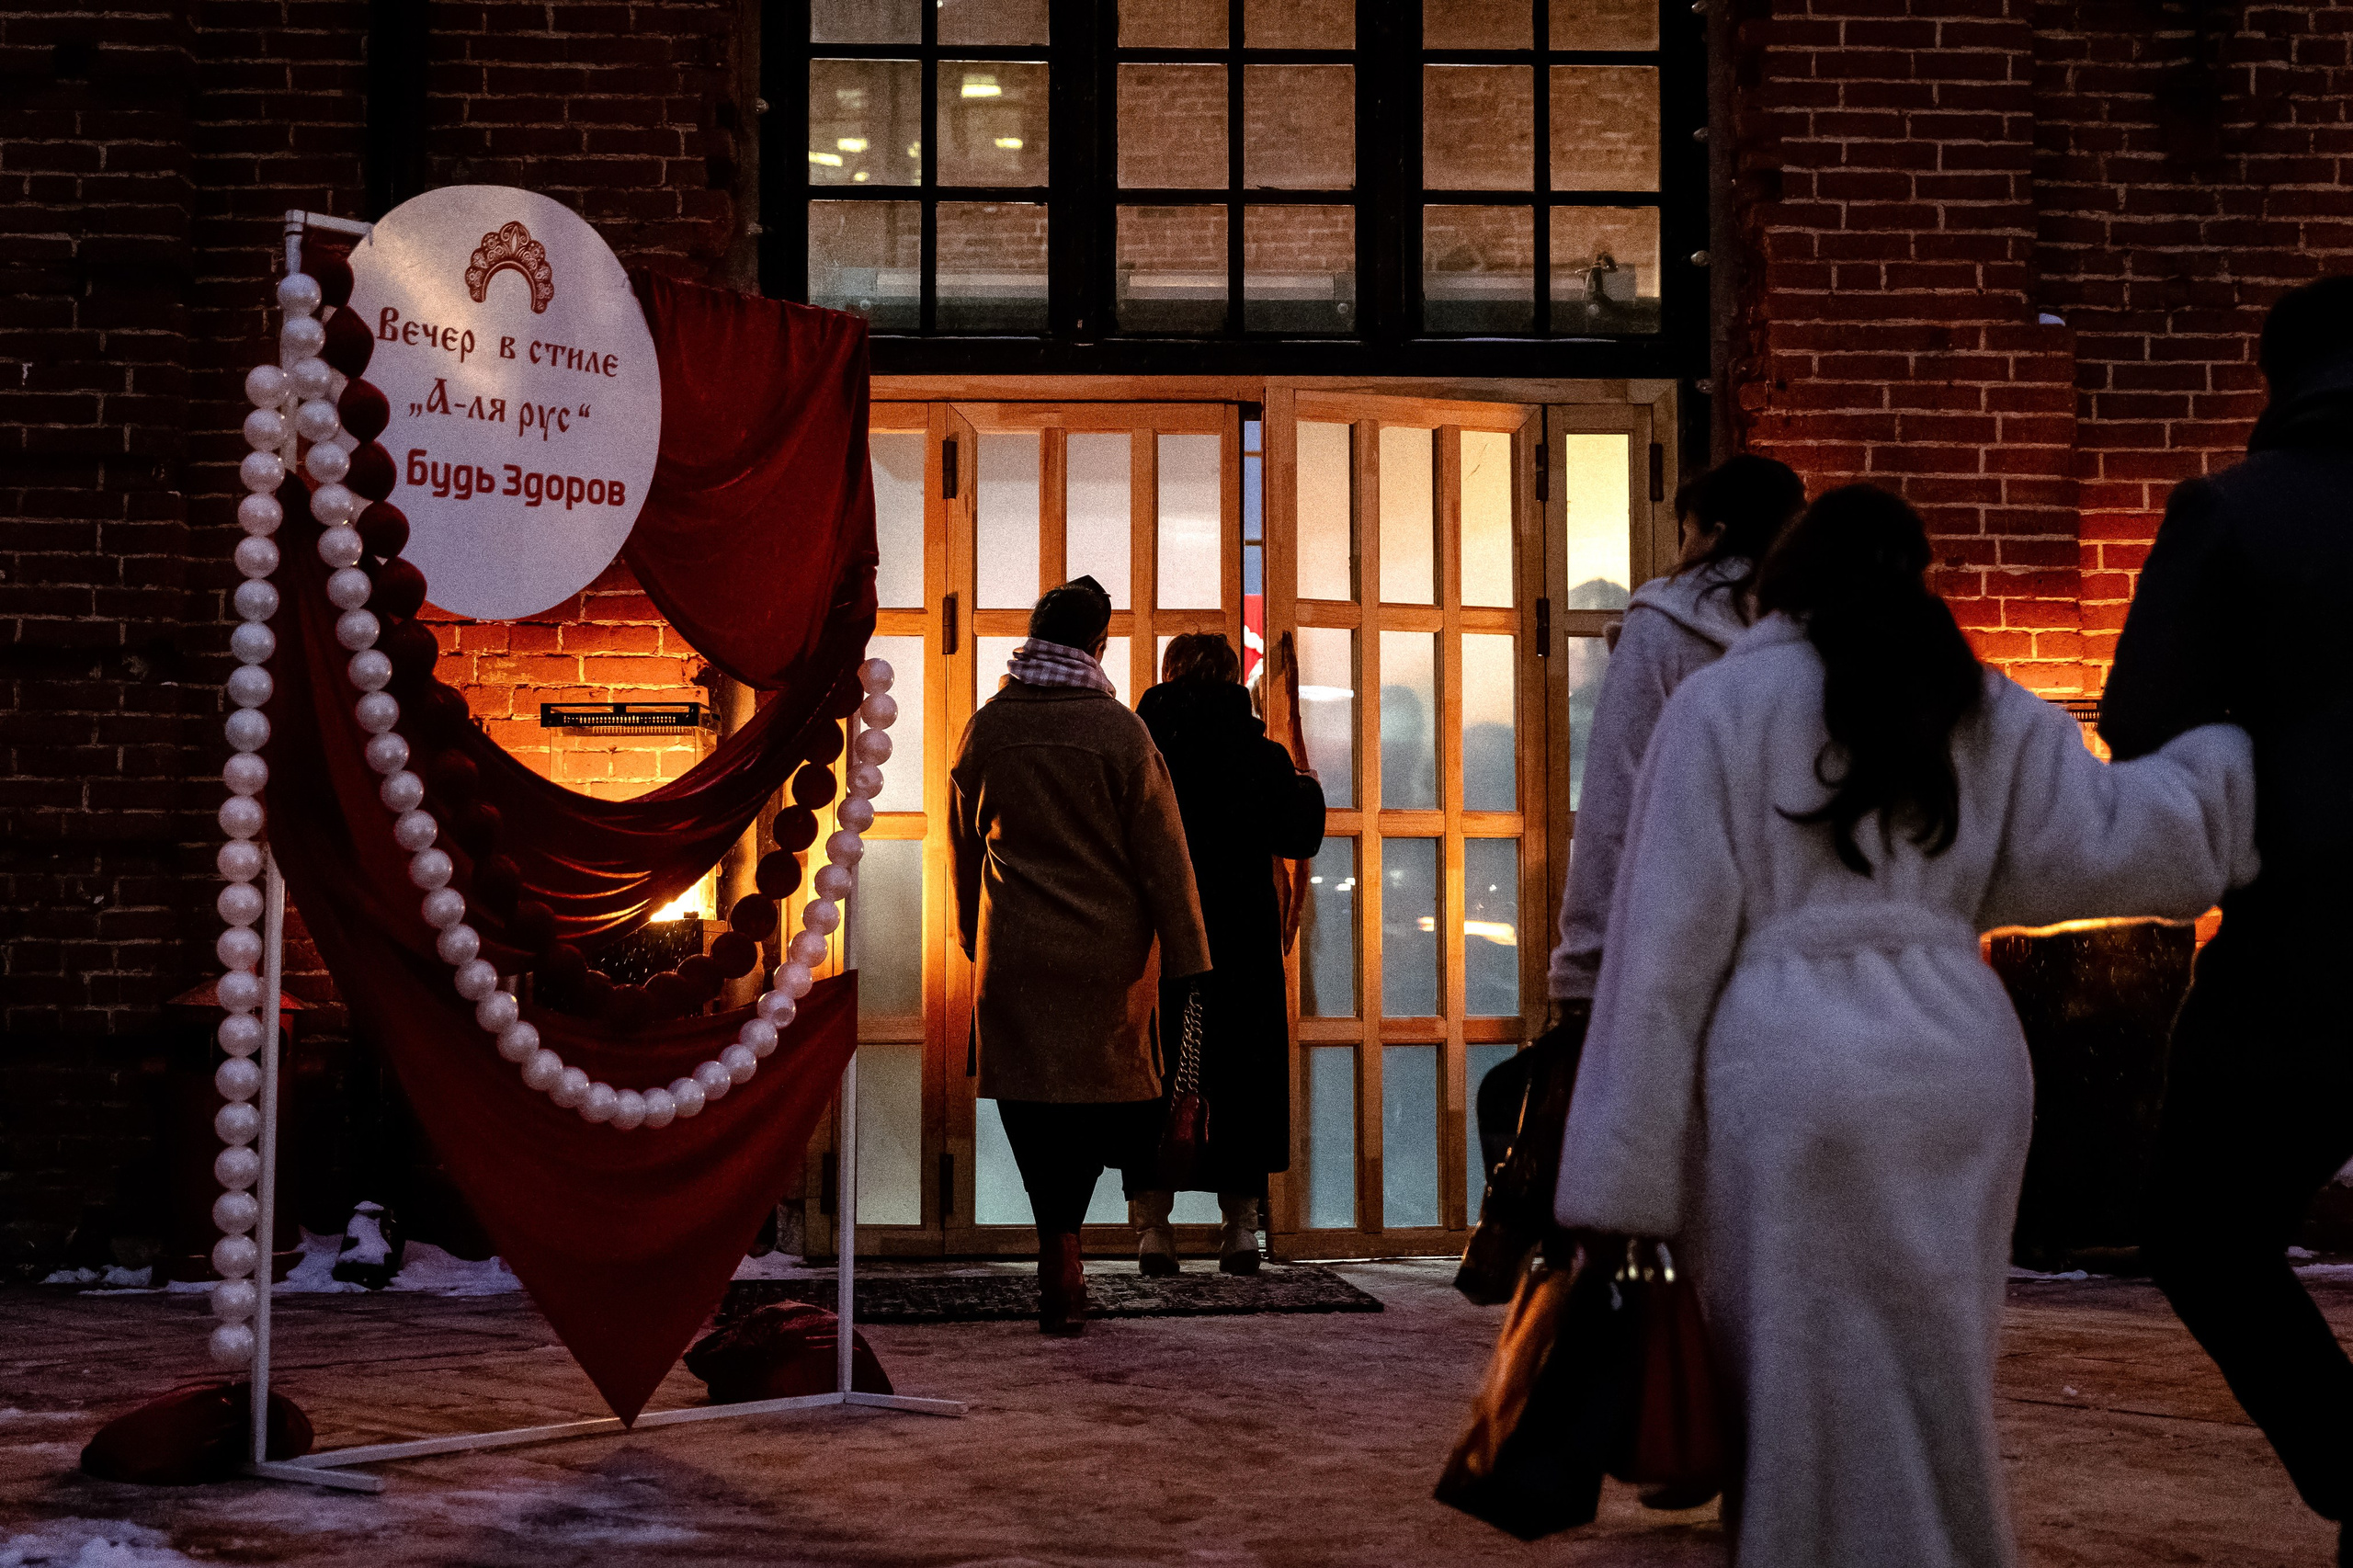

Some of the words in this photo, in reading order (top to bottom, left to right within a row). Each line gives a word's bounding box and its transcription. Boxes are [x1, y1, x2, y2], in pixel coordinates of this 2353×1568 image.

[376, 306, 476, 364] Вечер
[499, 335, 517, 360] в
[529, 339, 620, 378] стиле
[406, 448, 496, 501] Будь
[501, 463, 626, 511] Здоров
